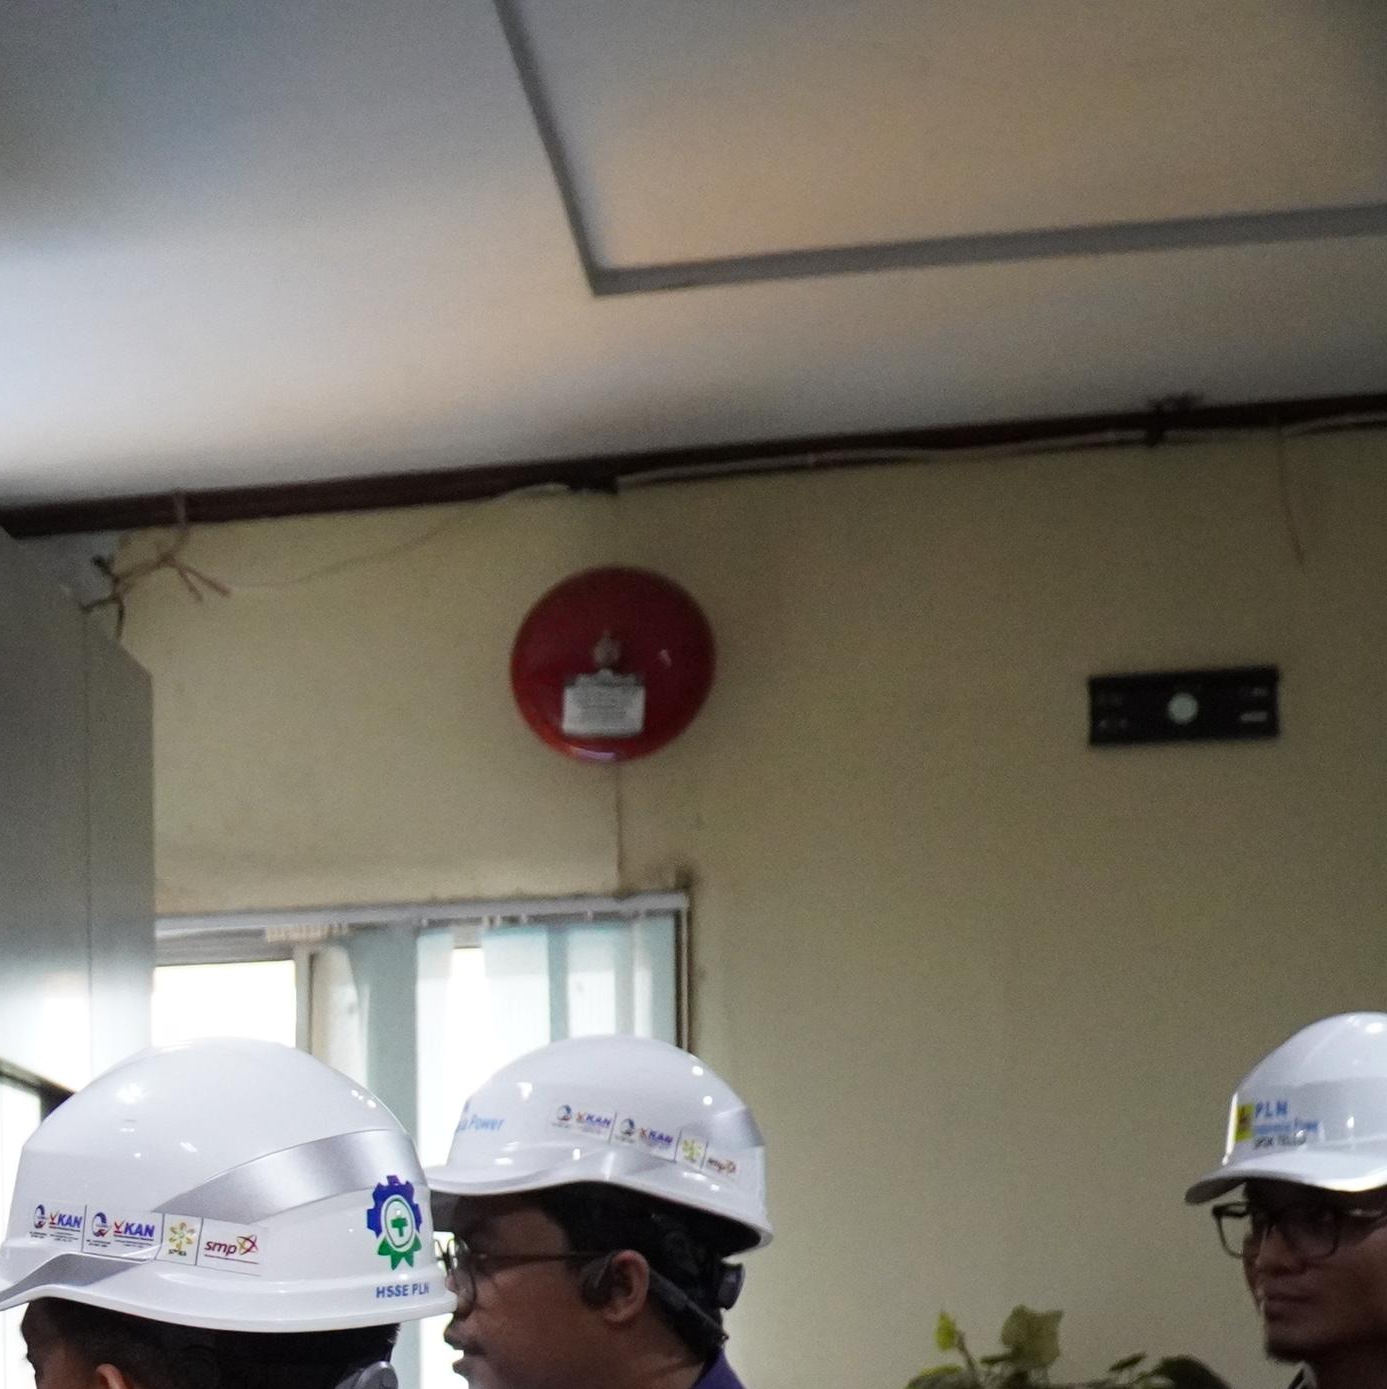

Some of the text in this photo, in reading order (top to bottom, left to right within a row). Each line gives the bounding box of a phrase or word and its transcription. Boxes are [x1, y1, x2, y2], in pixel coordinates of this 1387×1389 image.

[57, 1213, 83, 1229] KAN
[124, 1222, 155, 1238] KAN
[205, 1240, 237, 1257] smp
[376, 1284, 408, 1298] HSSE
